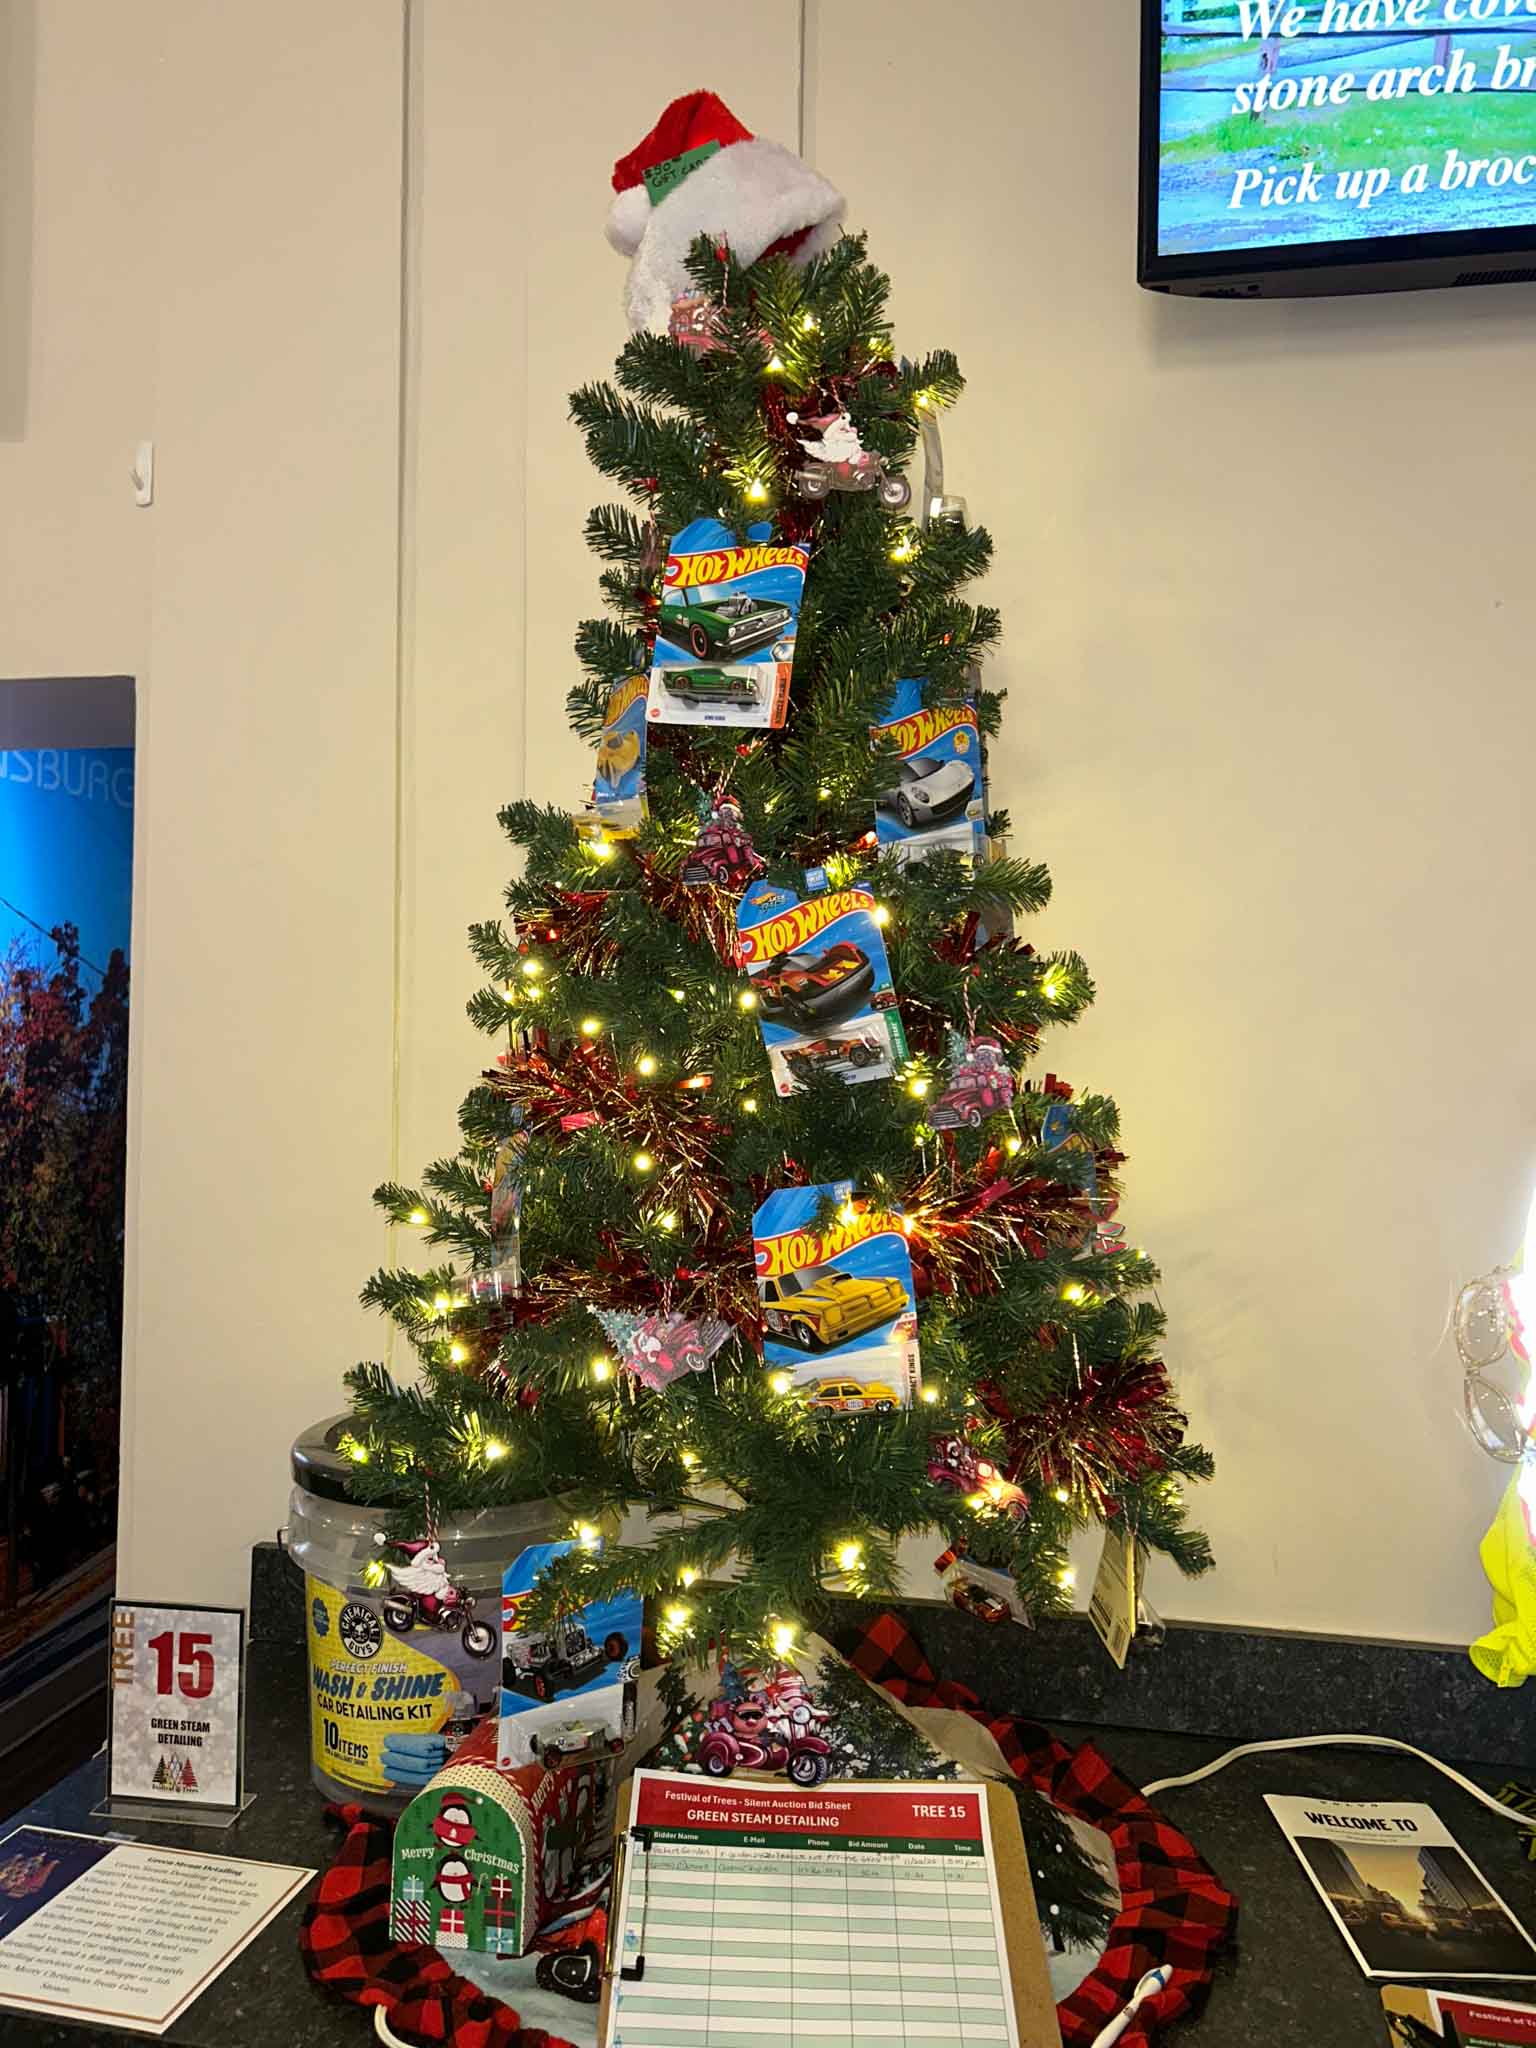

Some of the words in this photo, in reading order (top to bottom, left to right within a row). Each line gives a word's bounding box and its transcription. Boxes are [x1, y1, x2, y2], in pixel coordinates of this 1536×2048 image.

[1237, 0, 1304, 42] We
[1316, 0, 1429, 33] have
[1231, 71, 1356, 115] stone
[1366, 49, 1477, 101] arch
[1226, 163, 1324, 209] Pick
[1334, 168, 1391, 209] up
[1400, 162, 1429, 194] a
[1440, 148, 1536, 191] broc
[112, 1612, 135, 1689] TREE
[348, 1641, 373, 1655] GUYS
[148, 1631, 215, 1700] 15
[371, 1672, 447, 1701] SHINE
[317, 1693, 334, 1712] CAR
[336, 1700, 404, 1720] DETAILING
[407, 1704, 432, 1720] KIT
[151, 1718, 179, 1730] GREEN
[180, 1720, 211, 1733] STEAM
[158, 1733, 203, 1747] DETAILING
[323, 1718, 339, 1750] 10
[338, 1738, 369, 1759] ITEMS
[665, 1790, 701, 1802] Festival
[702, 1795, 711, 1803] of
[713, 1796, 737, 1806] Trees
[744, 1798, 770, 1808] Silent
[771, 1799, 807, 1809] Auction
[808, 1801, 824, 1809] Bid
[825, 1802, 851, 1810] Sheet
[687, 1808, 729, 1823] GREEN
[731, 1812, 772, 1825] STEAM
[775, 1814, 840, 1827] DETAILING
[912, 1804, 947, 1818] TREE
[948, 1806, 966, 1818] 15
[1303, 1811, 1392, 1831] WELCOME
[1390, 1819, 1418, 1832] TO
[654, 1831, 677, 1839] Bidder
[807, 1838, 830, 1847] Phone
[848, 1840, 860, 1848] Bid
[861, 1841, 889, 1849] Amount
[401, 1846, 434, 1860] Merry
[464, 1849, 520, 1874] Christmas
